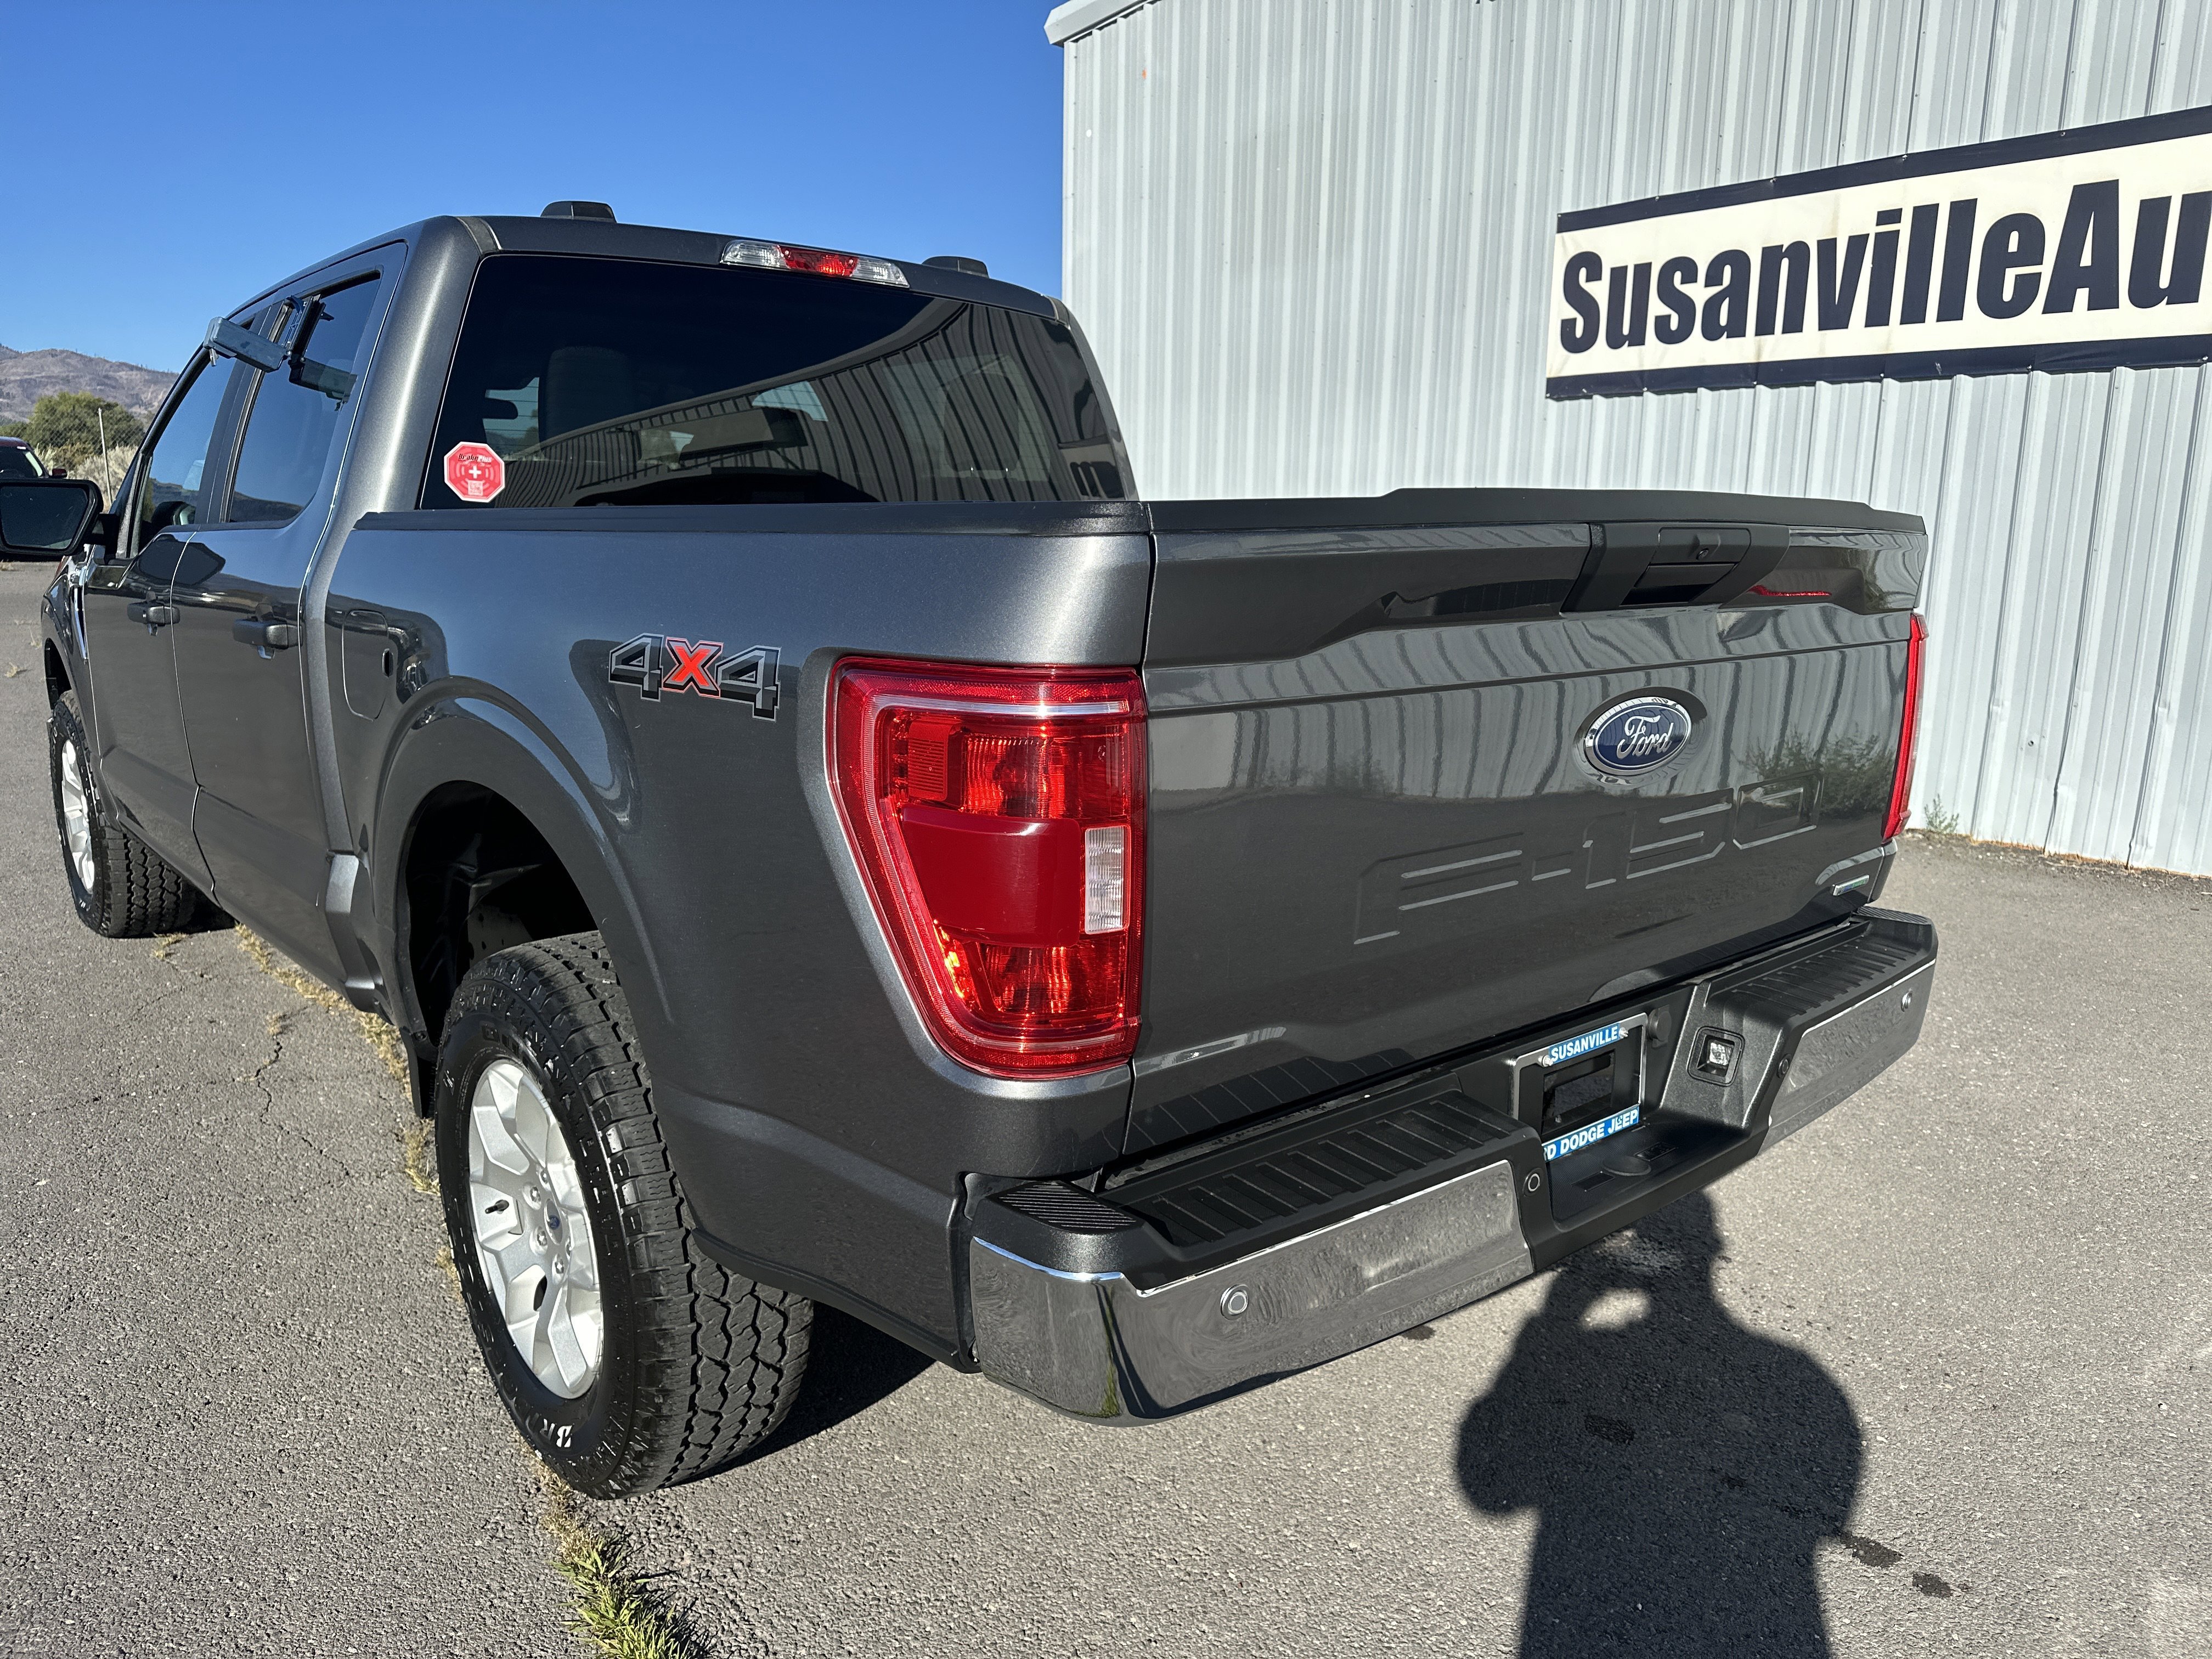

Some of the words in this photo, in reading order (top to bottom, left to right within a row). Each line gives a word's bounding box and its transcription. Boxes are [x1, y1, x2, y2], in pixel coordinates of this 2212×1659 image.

[1616, 715, 1674, 759] Ford
[1551, 1026, 1618, 1062] SUSANVILLE
[1560, 1122, 1605, 1154] DODGE
[1607, 1109, 1638, 1133] JEEP
